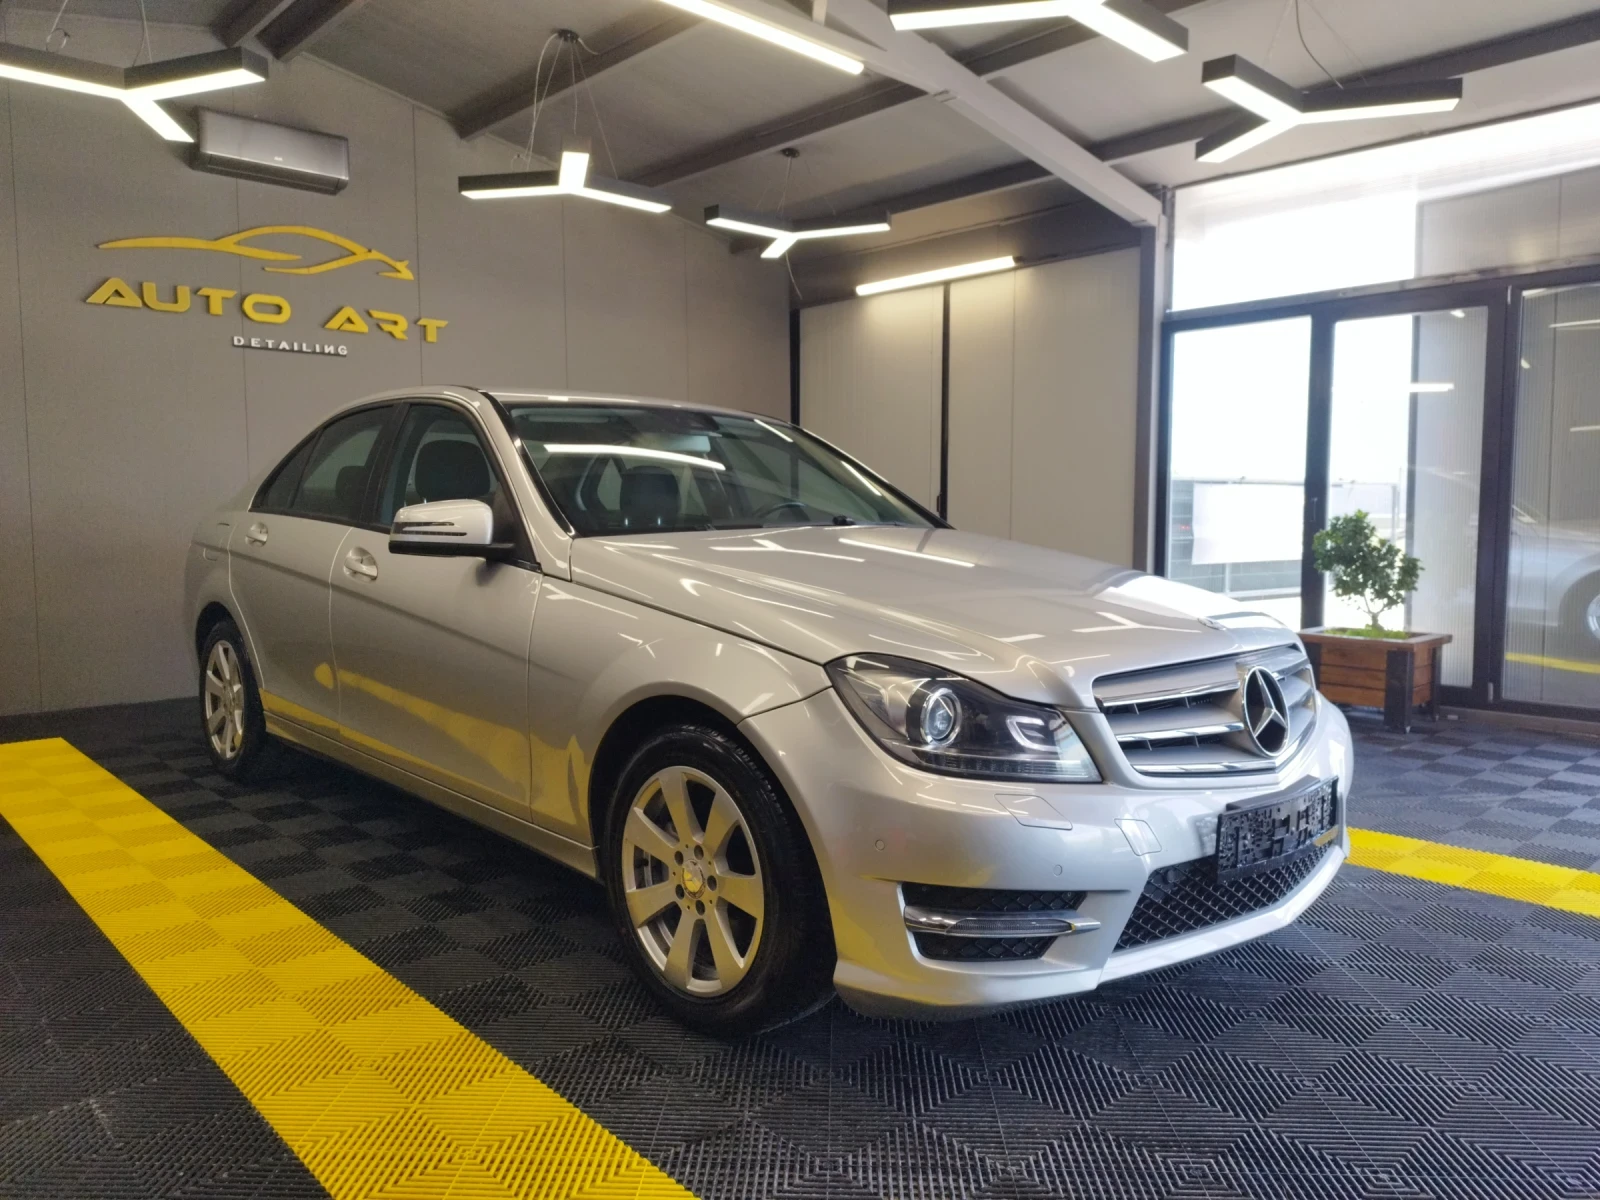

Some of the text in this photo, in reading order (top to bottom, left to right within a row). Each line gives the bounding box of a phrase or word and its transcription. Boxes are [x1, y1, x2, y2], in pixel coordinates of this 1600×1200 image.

[86, 277, 449, 344] AUTO ART
[232, 335, 348, 356] DETAILING
